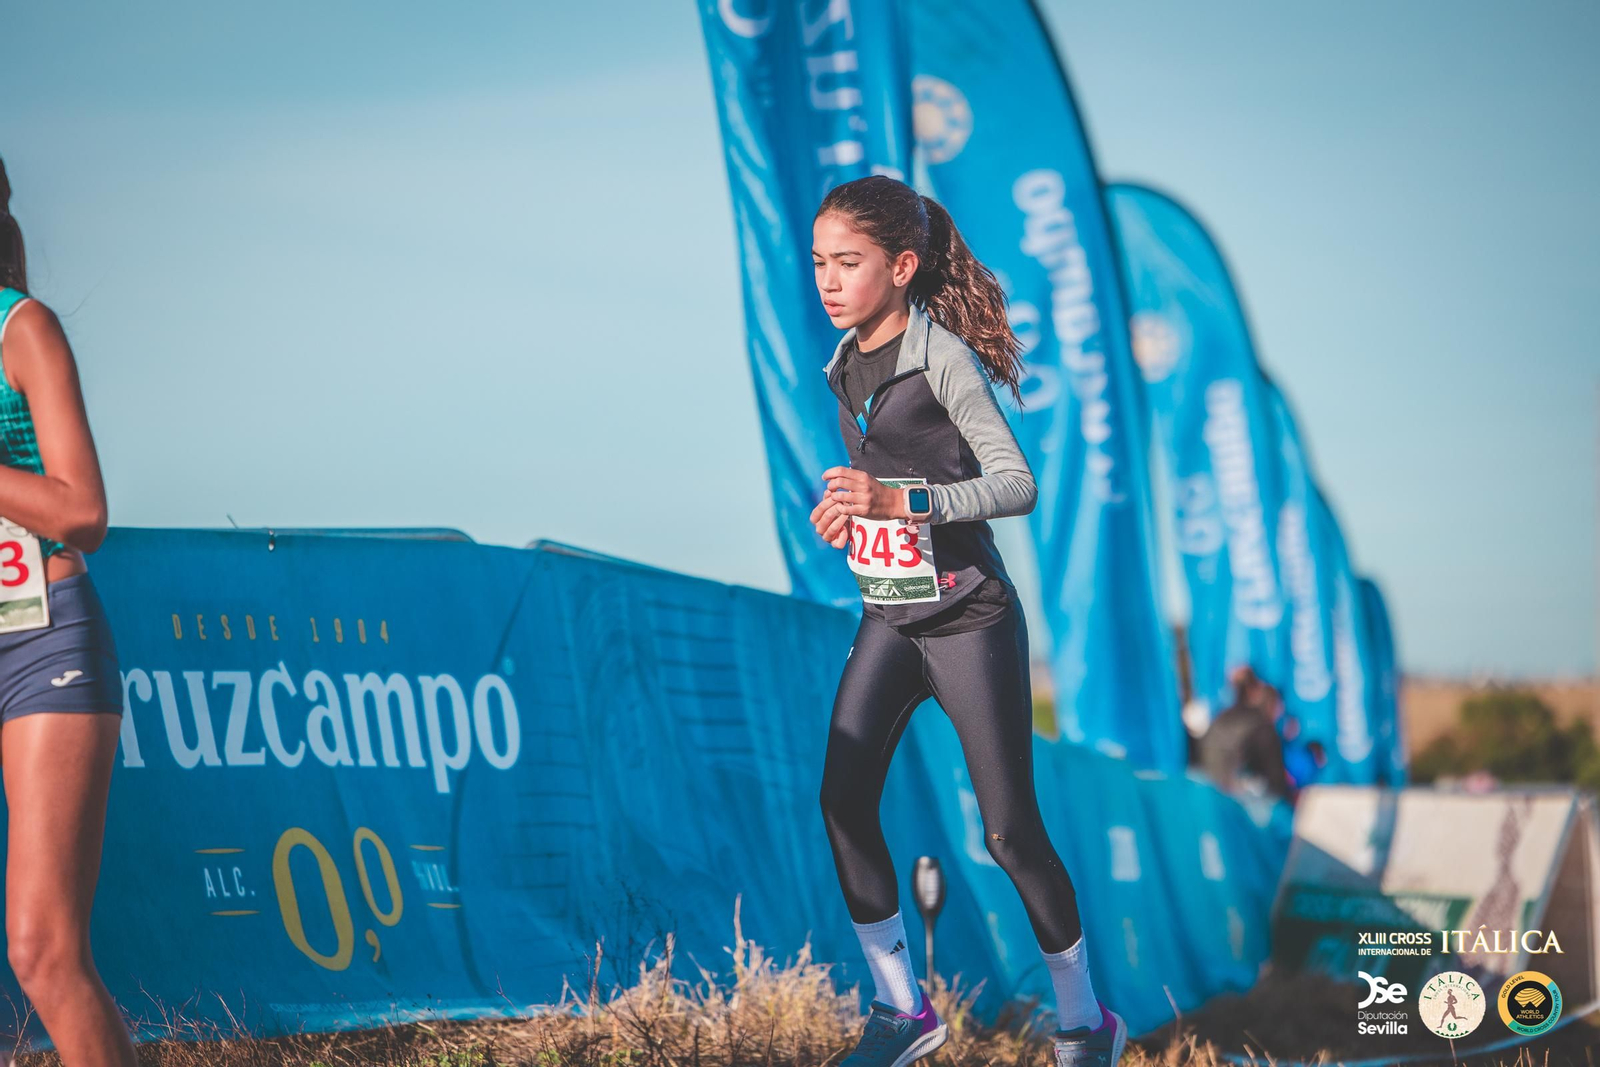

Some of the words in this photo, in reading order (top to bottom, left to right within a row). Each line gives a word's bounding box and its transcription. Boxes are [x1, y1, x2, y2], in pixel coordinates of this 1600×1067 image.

[173, 613, 279, 641] DESDE
[310, 617, 389, 644] 1904
[119, 661, 520, 794] ruzcampo
[204, 867, 256, 898] ALC.
[272, 826, 404, 971] 0,0
